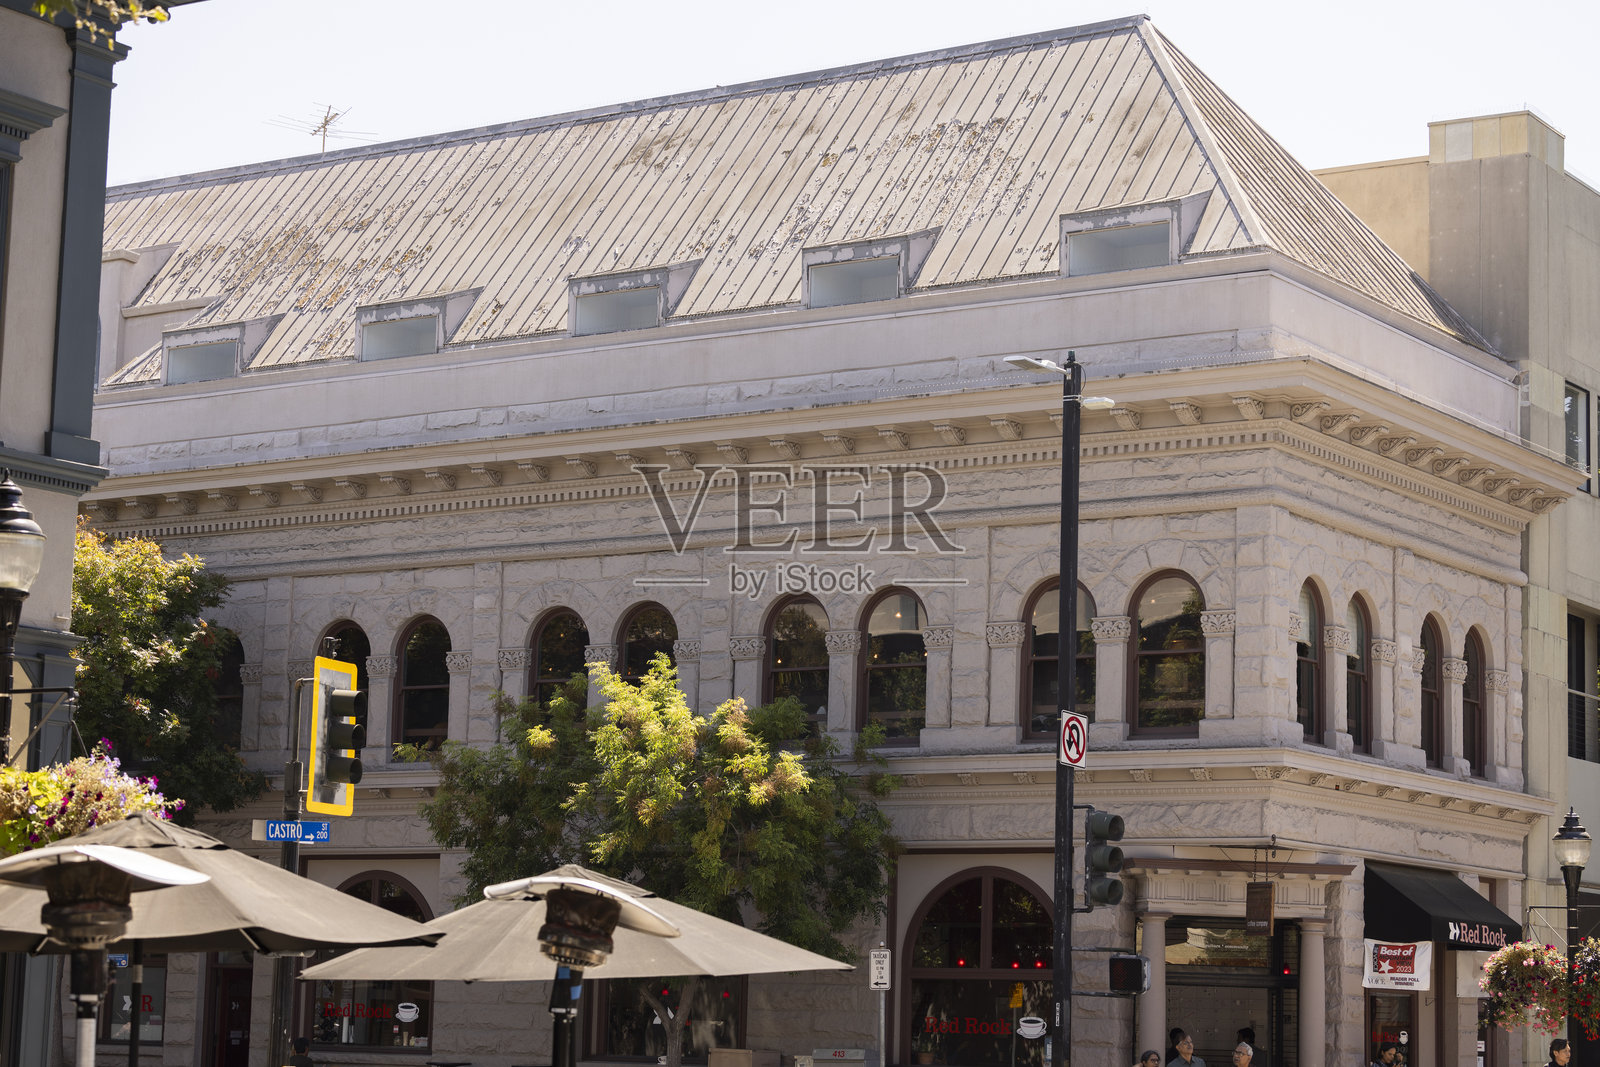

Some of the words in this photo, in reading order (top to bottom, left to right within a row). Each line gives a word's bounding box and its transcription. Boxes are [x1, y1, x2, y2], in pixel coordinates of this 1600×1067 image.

[268, 823, 303, 839] CASTRO
[321, 823, 328, 831] ST
[316, 831, 328, 839] 200
[1460, 922, 1480, 944] Red
[1481, 925, 1507, 947] Rock
[1380, 946, 1402, 956] Best
[1402, 946, 1414, 956] of
[1396, 965, 1412, 973] 2023
[323, 1002, 351, 1017] Red
[354, 1003, 392, 1018] Rock
[924, 1016, 960, 1034] Red
[963, 1017, 1012, 1035] Rock
[832, 1050, 846, 1058] 413
